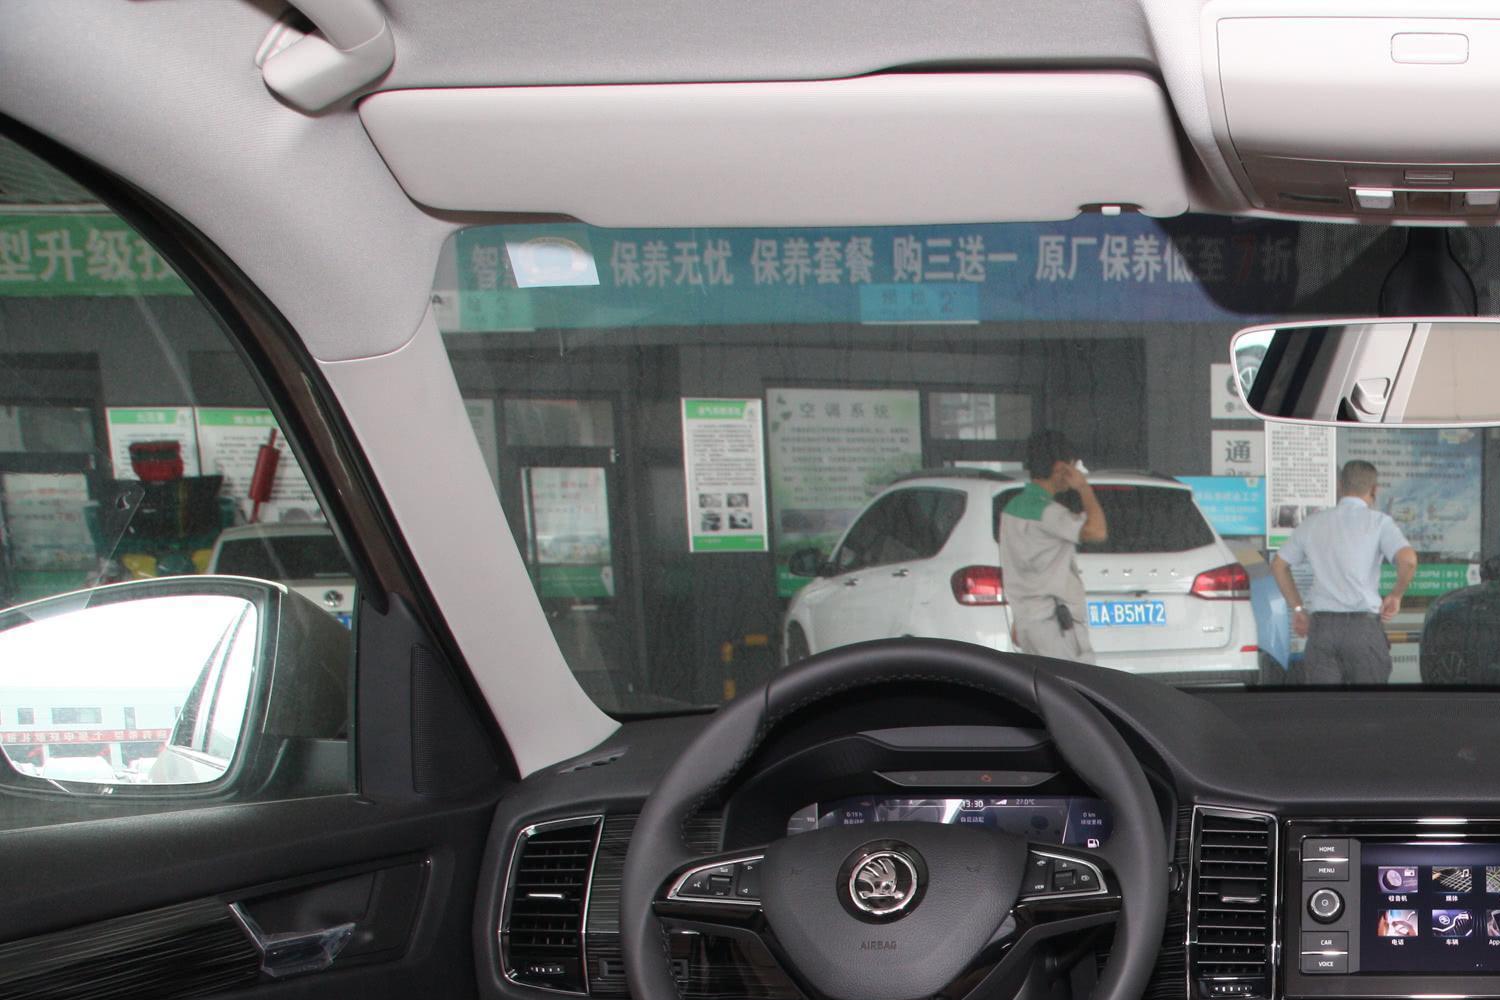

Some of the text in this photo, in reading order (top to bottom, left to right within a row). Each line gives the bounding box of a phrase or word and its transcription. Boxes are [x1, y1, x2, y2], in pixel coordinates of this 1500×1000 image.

[611, 239, 733, 288] 保养无忧
[750, 236, 875, 286] 保养套餐
[892, 235, 1018, 284] 购三送一
[1224, 439, 1252, 464] 通
[860, 941, 898, 951] AIRBAG
